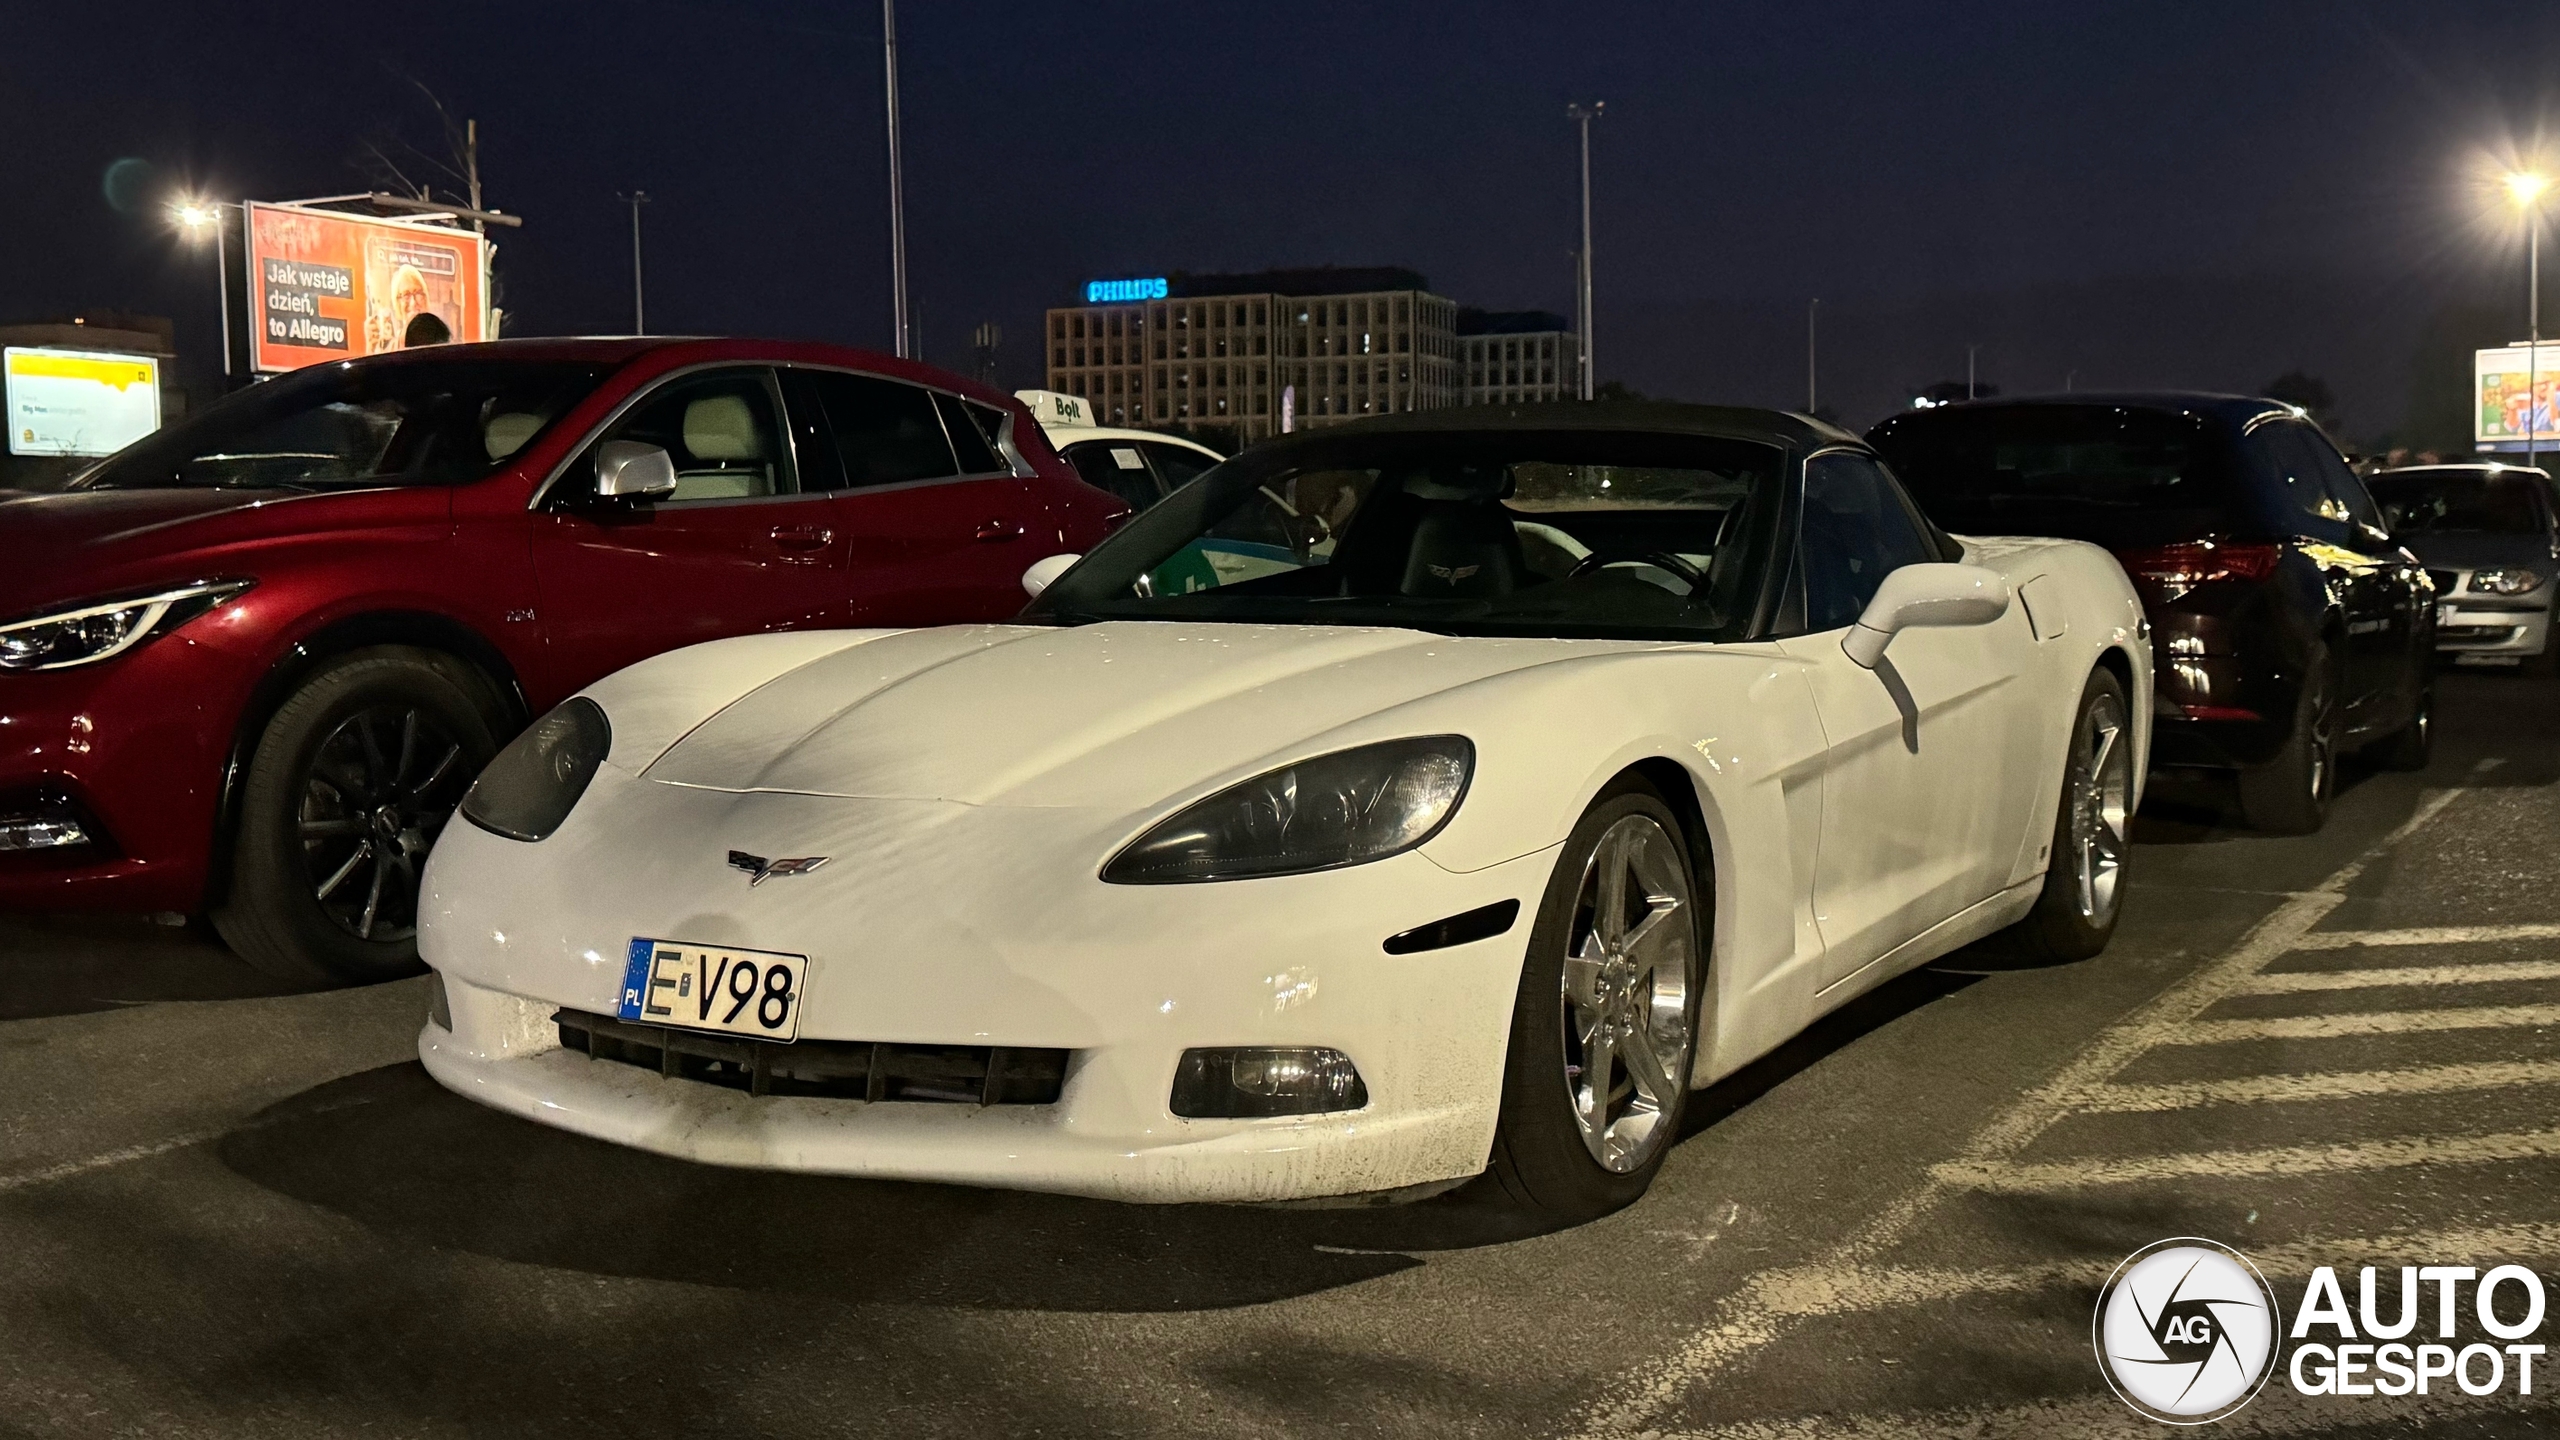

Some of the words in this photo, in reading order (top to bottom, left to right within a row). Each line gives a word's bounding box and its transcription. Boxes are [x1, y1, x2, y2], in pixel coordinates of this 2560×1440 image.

[267, 264, 298, 286] Jak
[299, 270, 350, 295] wstaje
[1087, 278, 1168, 302] PHILIPS
[268, 289, 315, 316] dzień,
[269, 317, 287, 337] to
[289, 318, 345, 346] Allegro
[1055, 396, 1081, 421] Bolt
[624, 988, 641, 1006] PL
[699, 954, 793, 1030] V98
